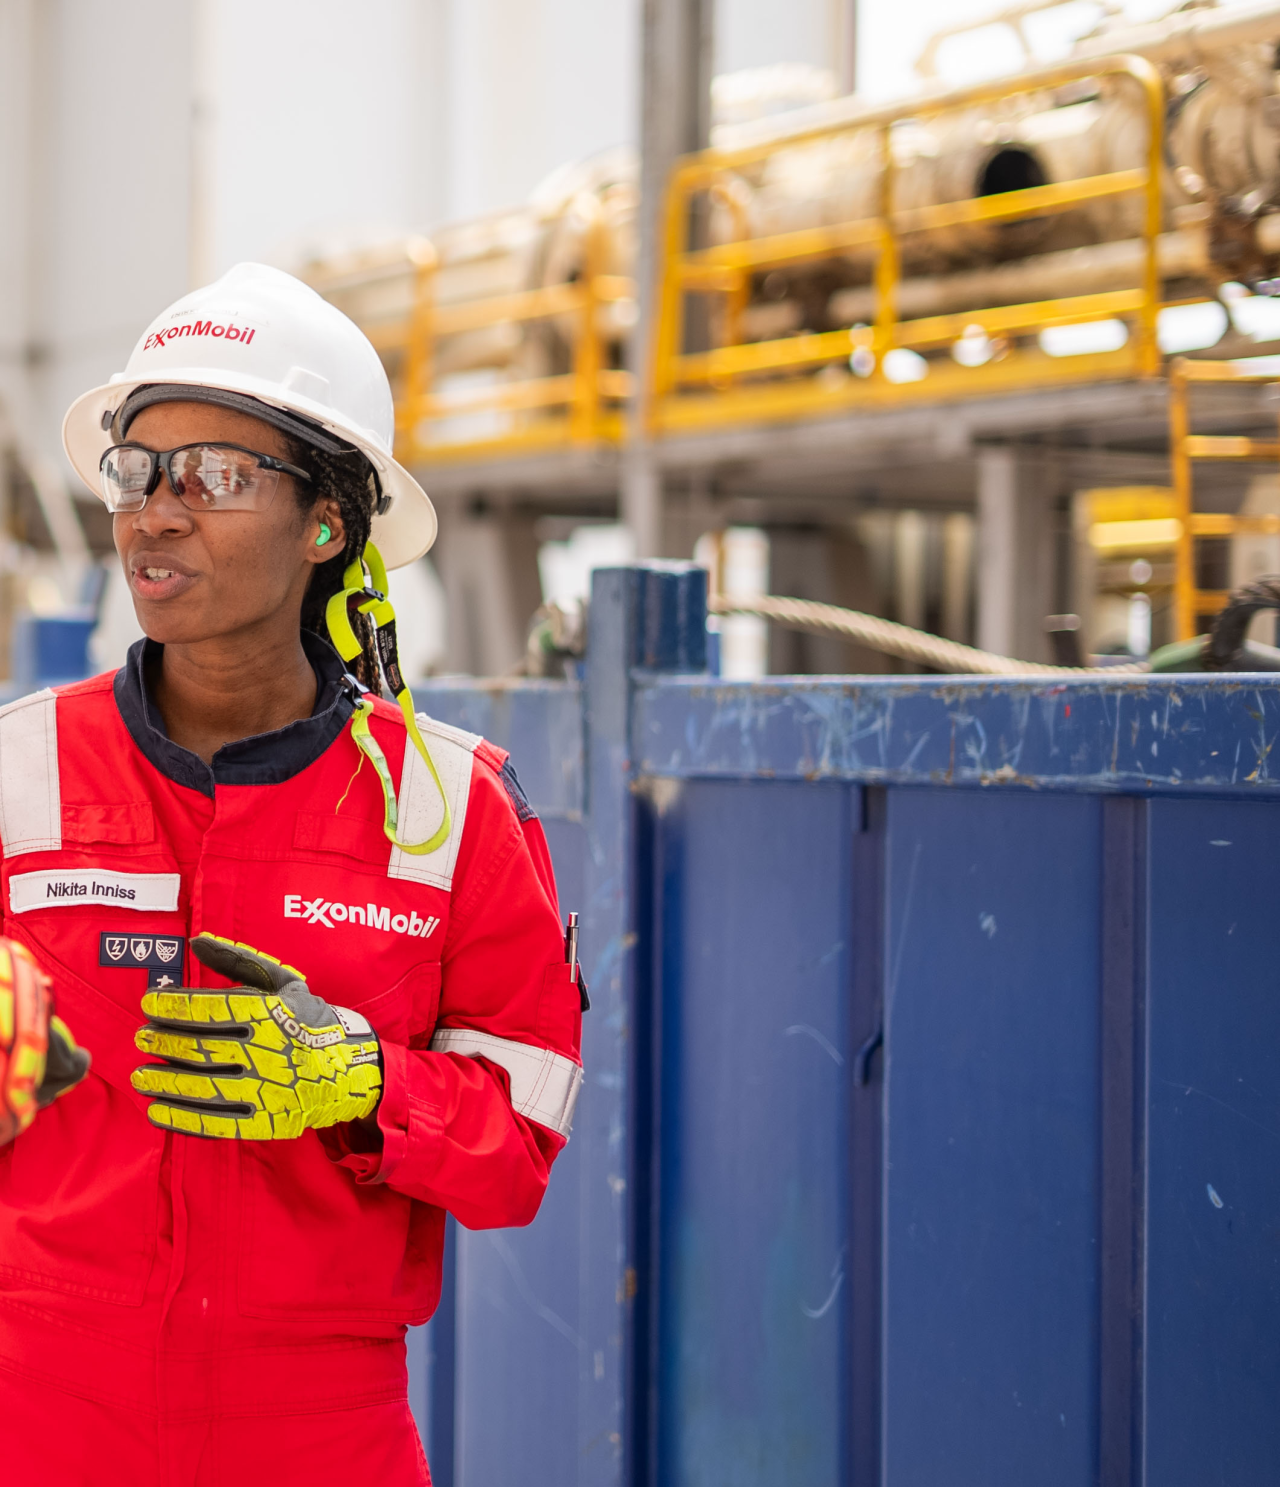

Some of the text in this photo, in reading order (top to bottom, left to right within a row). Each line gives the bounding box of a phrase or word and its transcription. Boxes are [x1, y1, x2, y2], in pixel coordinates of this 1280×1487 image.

[143, 320, 256, 351] ExxonMobil
[46, 881, 136, 900] Nikita Inniss
[284, 894, 441, 938] ExxonMobil
[272, 1005, 342, 1048] PREDATOR
